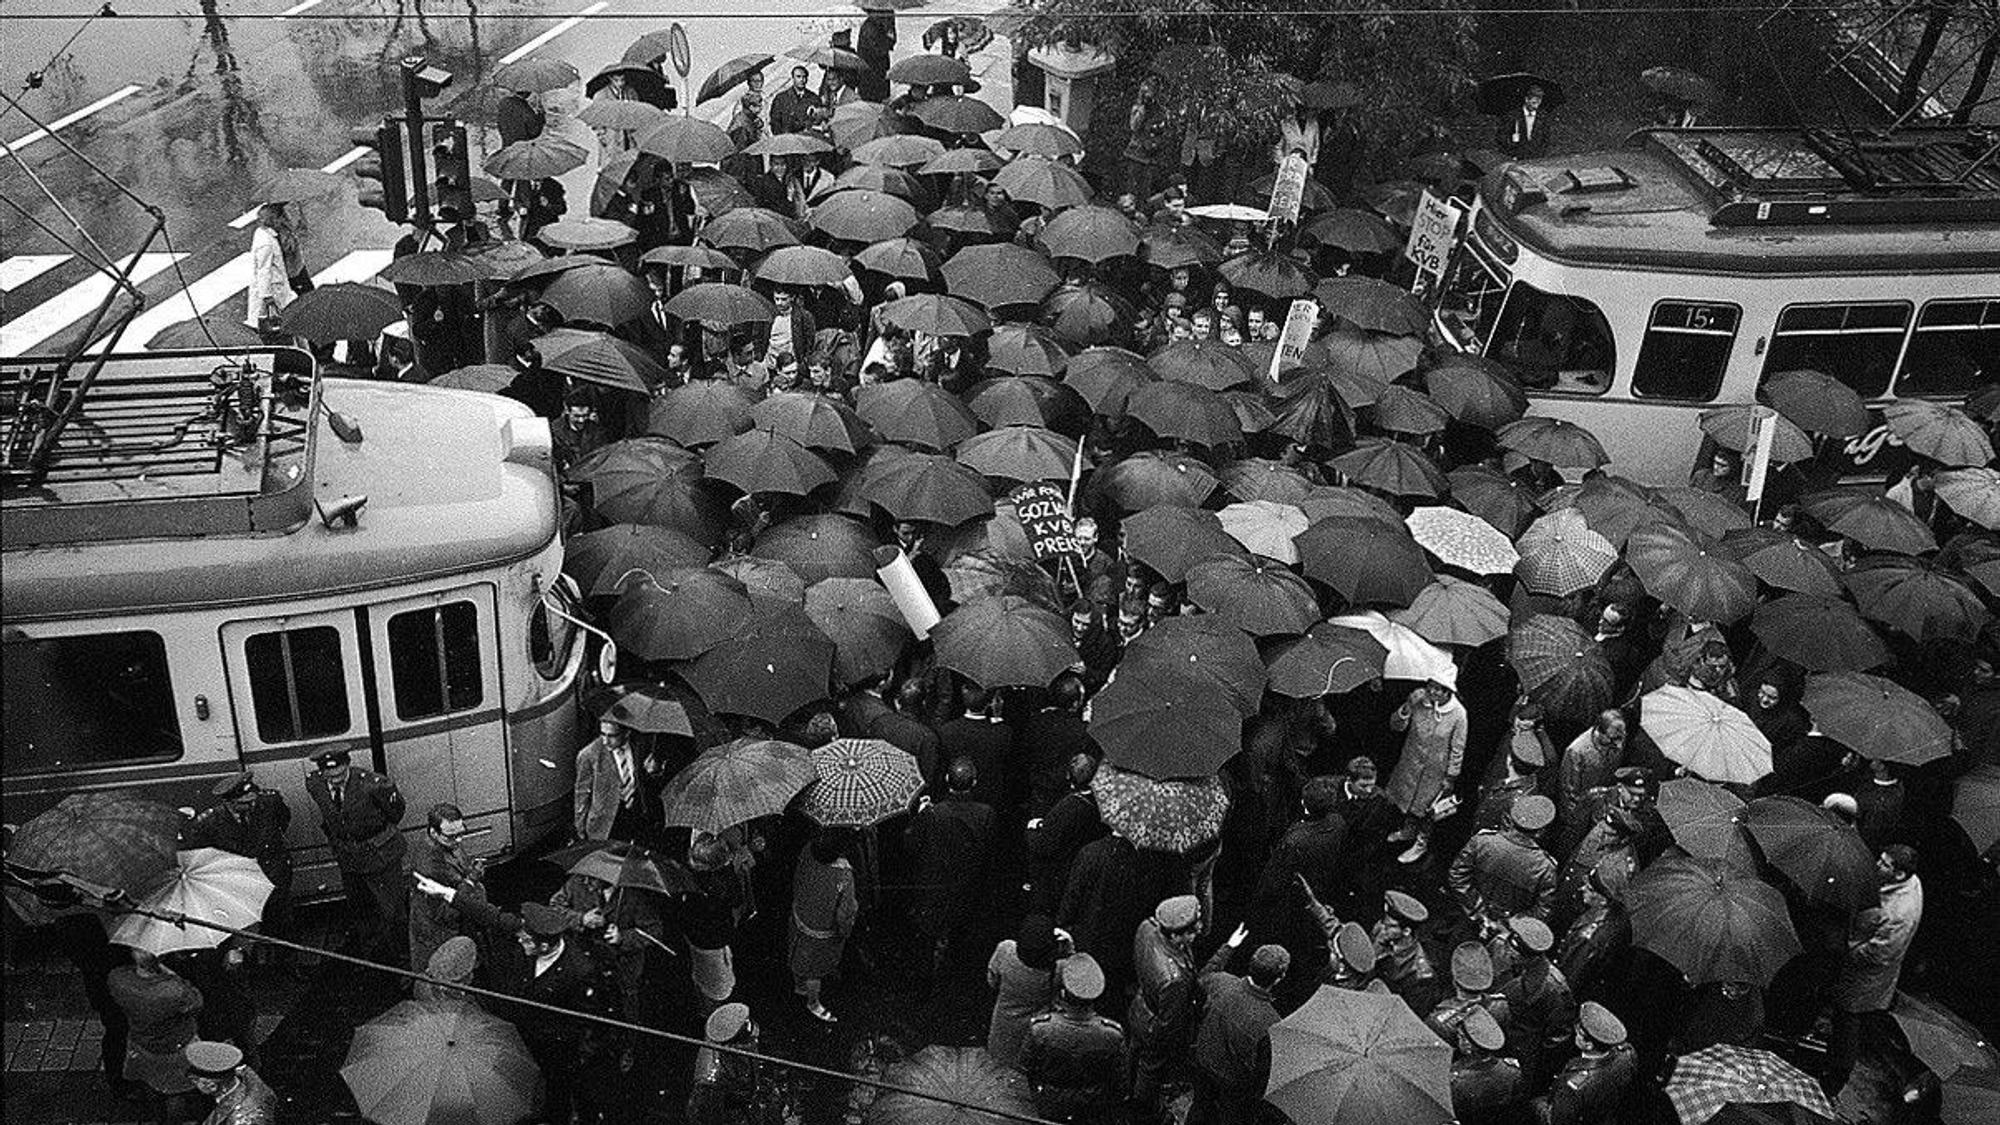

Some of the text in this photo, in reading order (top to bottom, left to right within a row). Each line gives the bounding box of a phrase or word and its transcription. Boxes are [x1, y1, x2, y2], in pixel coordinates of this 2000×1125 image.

[1419, 212, 1451, 237] STOP
[1411, 245, 1440, 269] KVB
[1686, 307, 1710, 328] 15
[1033, 520, 1074, 535] KVB
